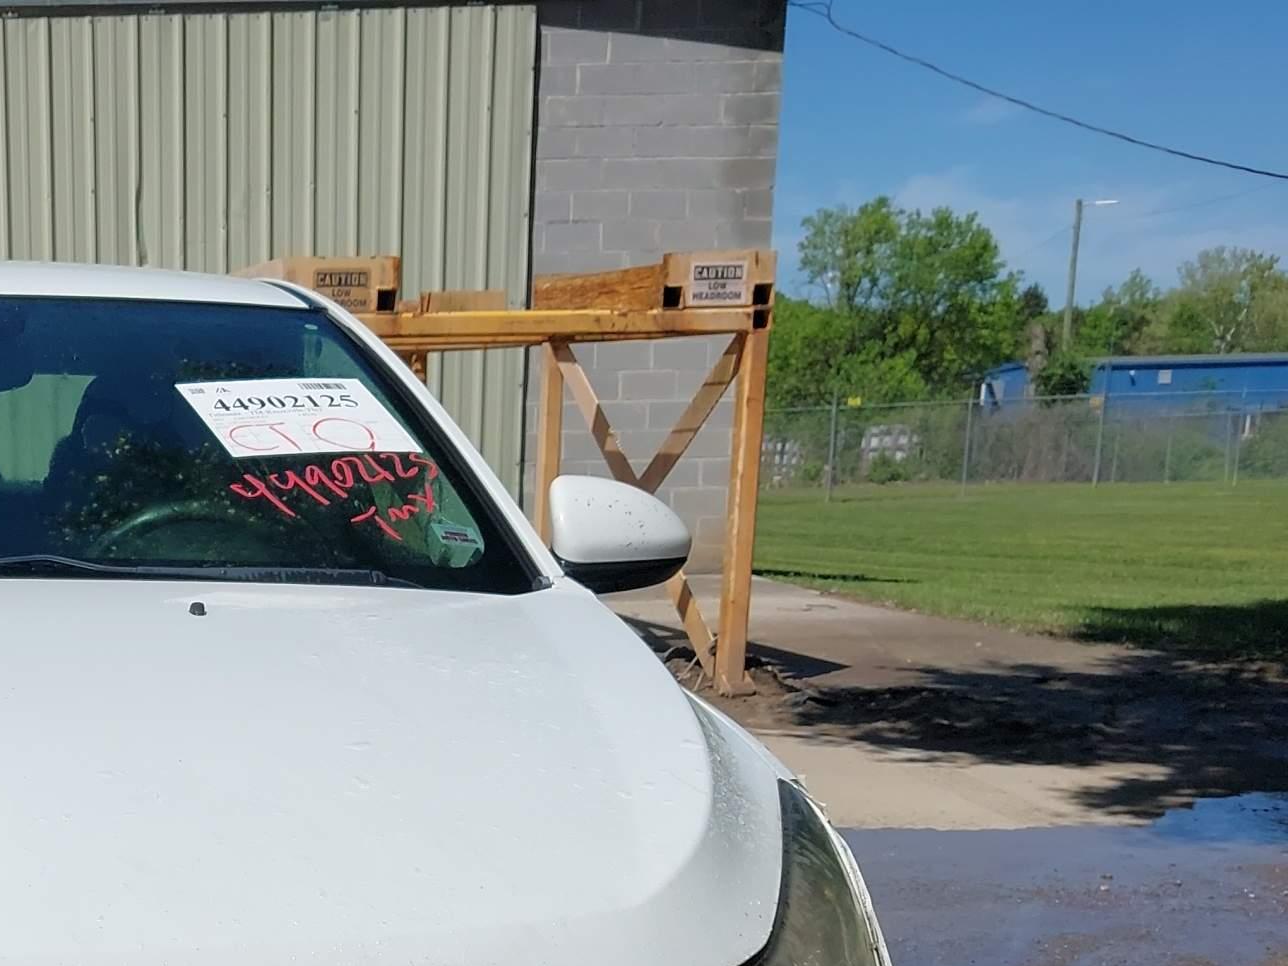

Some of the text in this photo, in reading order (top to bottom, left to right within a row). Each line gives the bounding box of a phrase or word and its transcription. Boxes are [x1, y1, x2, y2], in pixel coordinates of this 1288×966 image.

[695, 266, 742, 279] CAUTION
[318, 273, 367, 286] CAUTION
[708, 282, 727, 290] LOW
[332, 288, 351, 297] LOW
[693, 291, 741, 301] HEADROOM
[213, 394, 359, 412] 44902125
